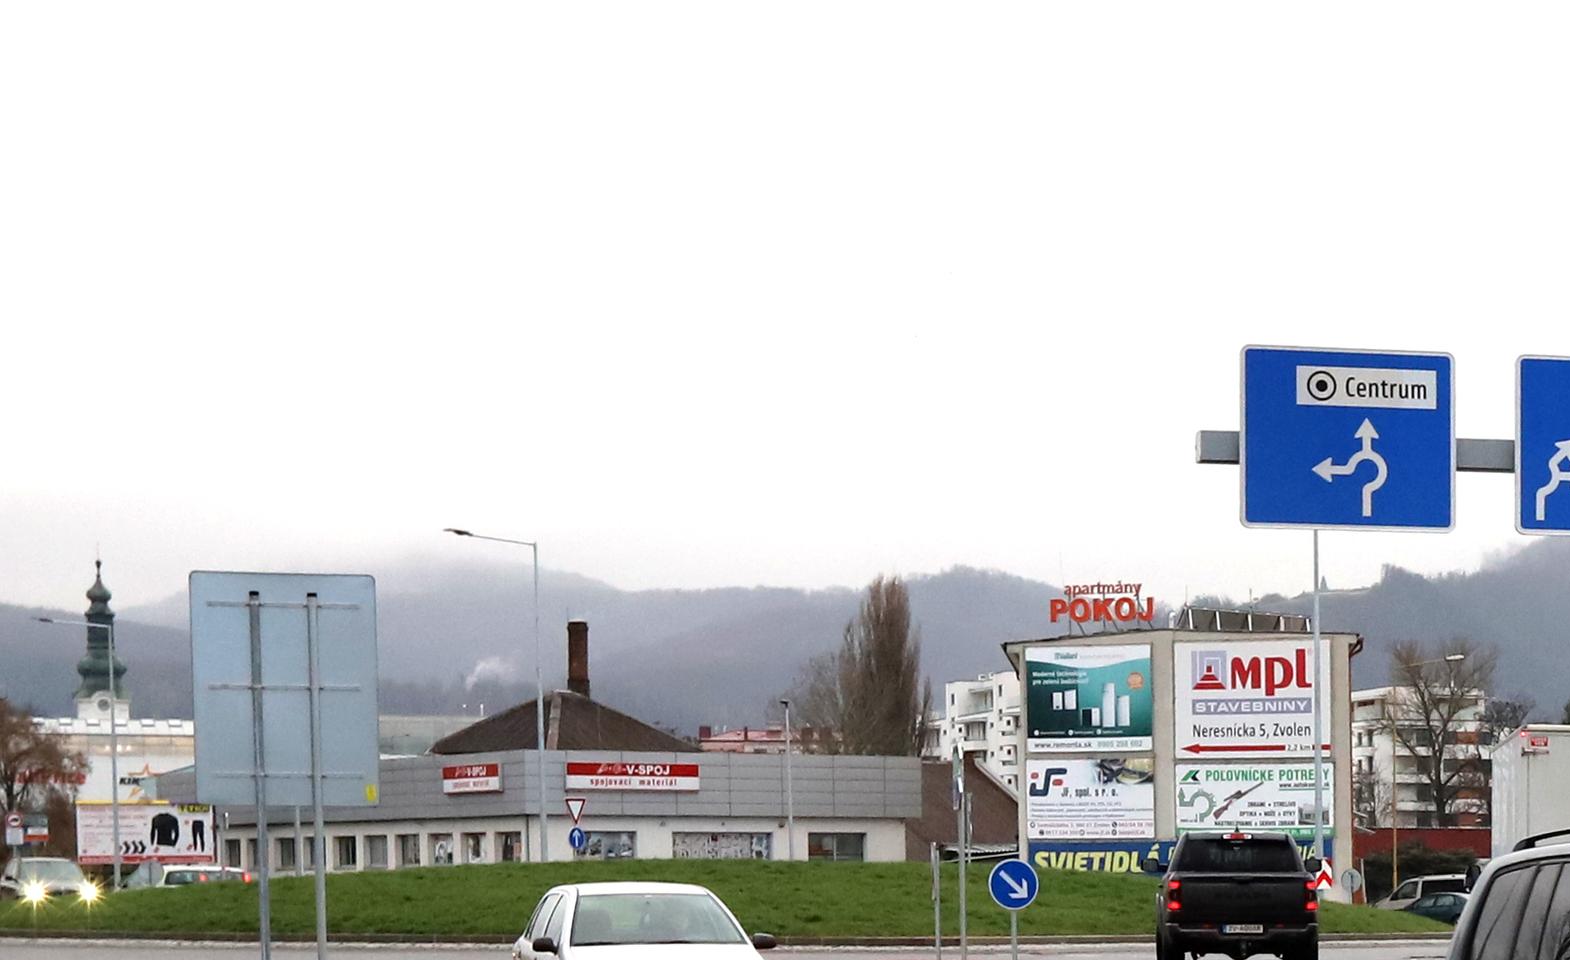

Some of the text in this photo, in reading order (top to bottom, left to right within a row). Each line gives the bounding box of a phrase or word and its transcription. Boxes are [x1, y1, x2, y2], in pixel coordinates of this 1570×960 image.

[1345, 377, 1427, 400] Centrum
[1064, 580, 1142, 598] apartmány
[1050, 597, 1154, 623] POKOJ
[1195, 700, 1308, 713] STAVEBNINY
[1193, 722, 1311, 739] Neresnícka 5, Zvolen
[1279, 769, 1330, 781] POTREY
